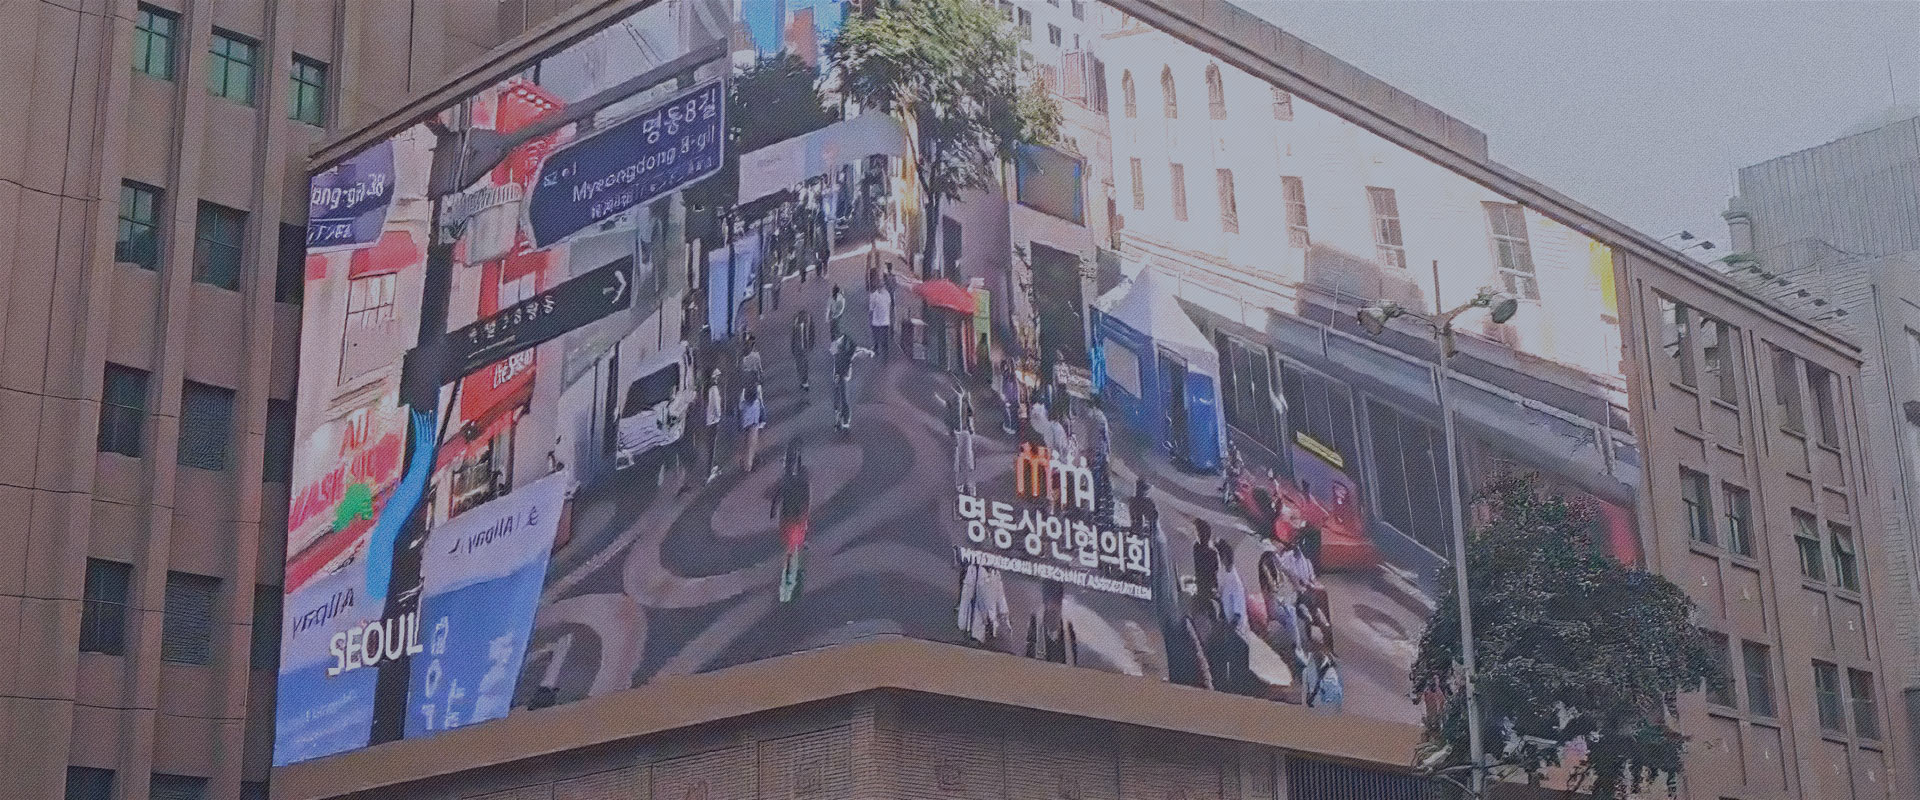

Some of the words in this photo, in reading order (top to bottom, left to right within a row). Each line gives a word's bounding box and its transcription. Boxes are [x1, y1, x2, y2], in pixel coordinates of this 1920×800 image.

[642, 89, 716, 144] 명동8길
[573, 147, 677, 202] Myeongdong
[959, 494, 1151, 577] 명동상인협의회
[328, 612, 424, 676] SEOUL
